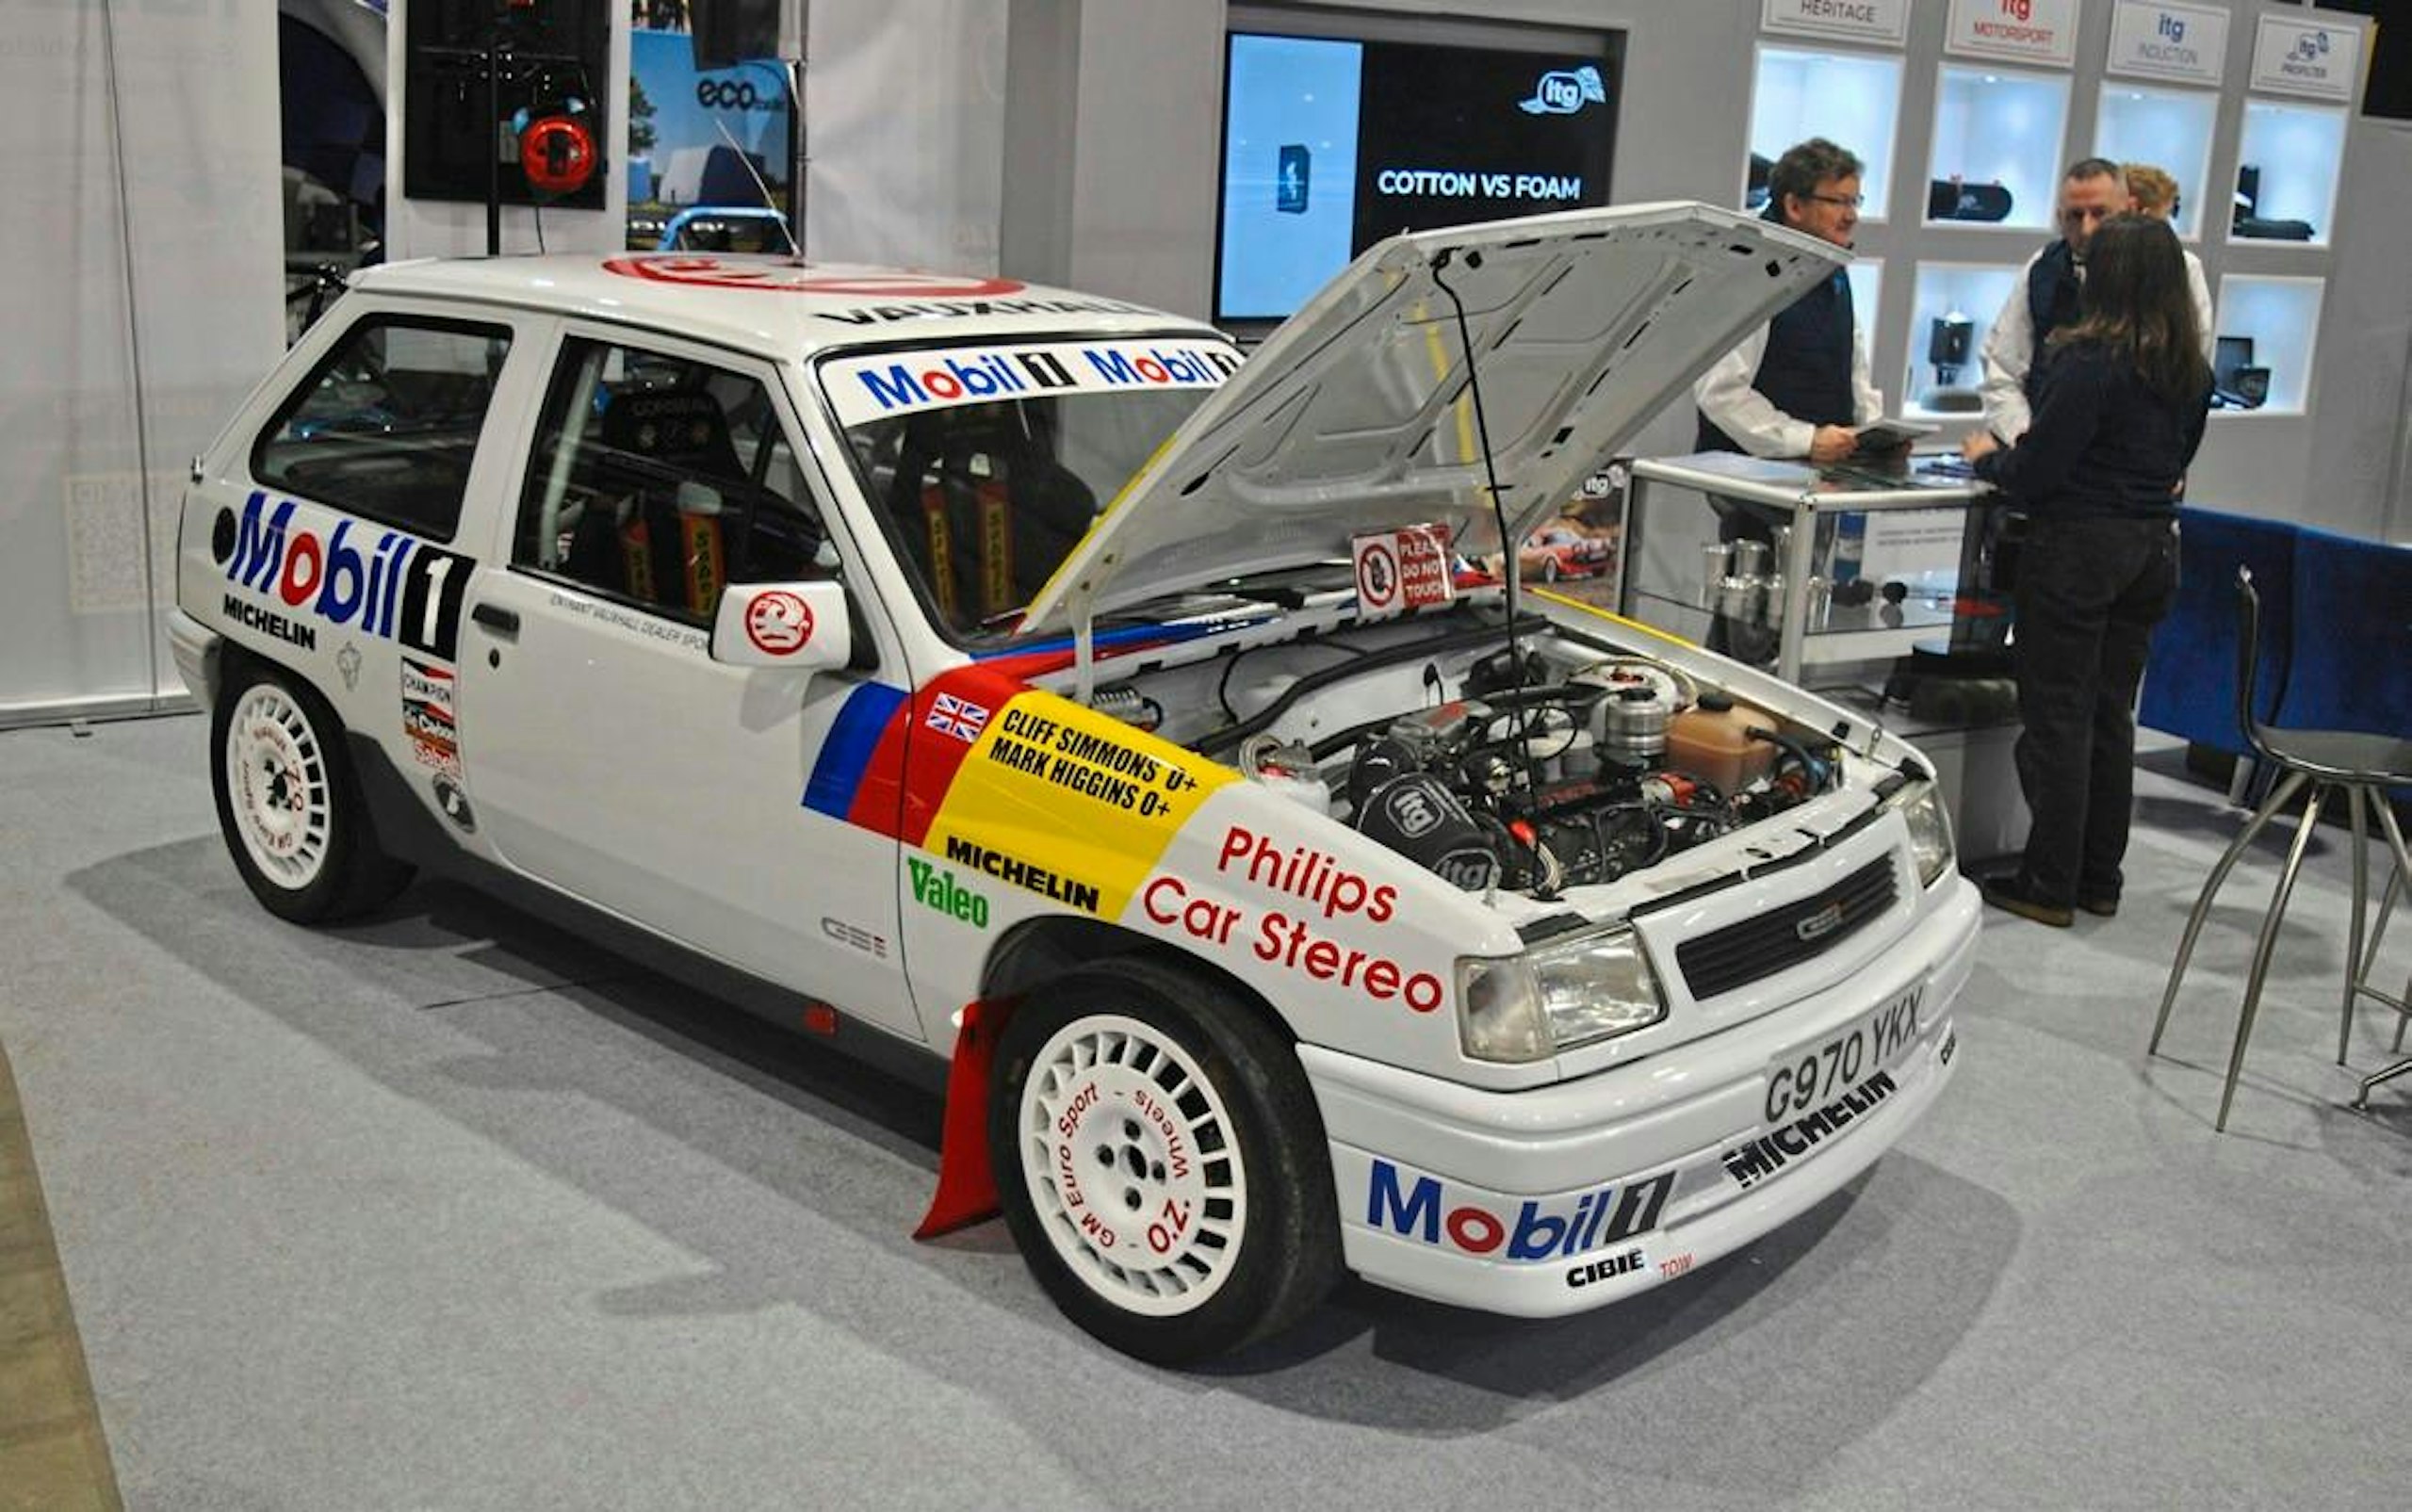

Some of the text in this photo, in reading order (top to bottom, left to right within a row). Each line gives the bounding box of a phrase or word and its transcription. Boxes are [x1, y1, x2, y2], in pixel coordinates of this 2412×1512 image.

[1801, 0, 1876, 23] HERITAGE
[1974, 22, 2054, 43] MOTORSPORT
[2159, 13, 2184, 42] itg
[697, 78, 757, 110] eco
[1378, 169, 1581, 201] COTTON VS FOAM
[856, 354, 1027, 410] Mobil
[1083, 347, 1219, 384] Mobil
[227, 490, 416, 639] Mobil
[222, 593, 317, 651] MICHELIN
[989, 737, 1047, 778] MARK
[1049, 758, 1135, 811] HIGGINS
[1002, 709, 1056, 744] CLIFF
[1056, 727, 1159, 782] SIMMONS
[906, 856, 989, 930] Valeo
[946, 837, 1100, 913] MICHELIN
[1217, 826, 1397, 923] Philips
[1143, 877, 1442, 1013] Car Stereo
[1765, 985, 1924, 1123] G970 YKX
[1057, 1082, 1116, 1248] GM Euro Sport
[1134, 1088, 1190, 1179] Wheels
[1721, 1069, 1898, 1189] MICHELIN
[1367, 1159, 1612, 1260] Mobil
[1659, 1252, 1697, 1279] TOW
